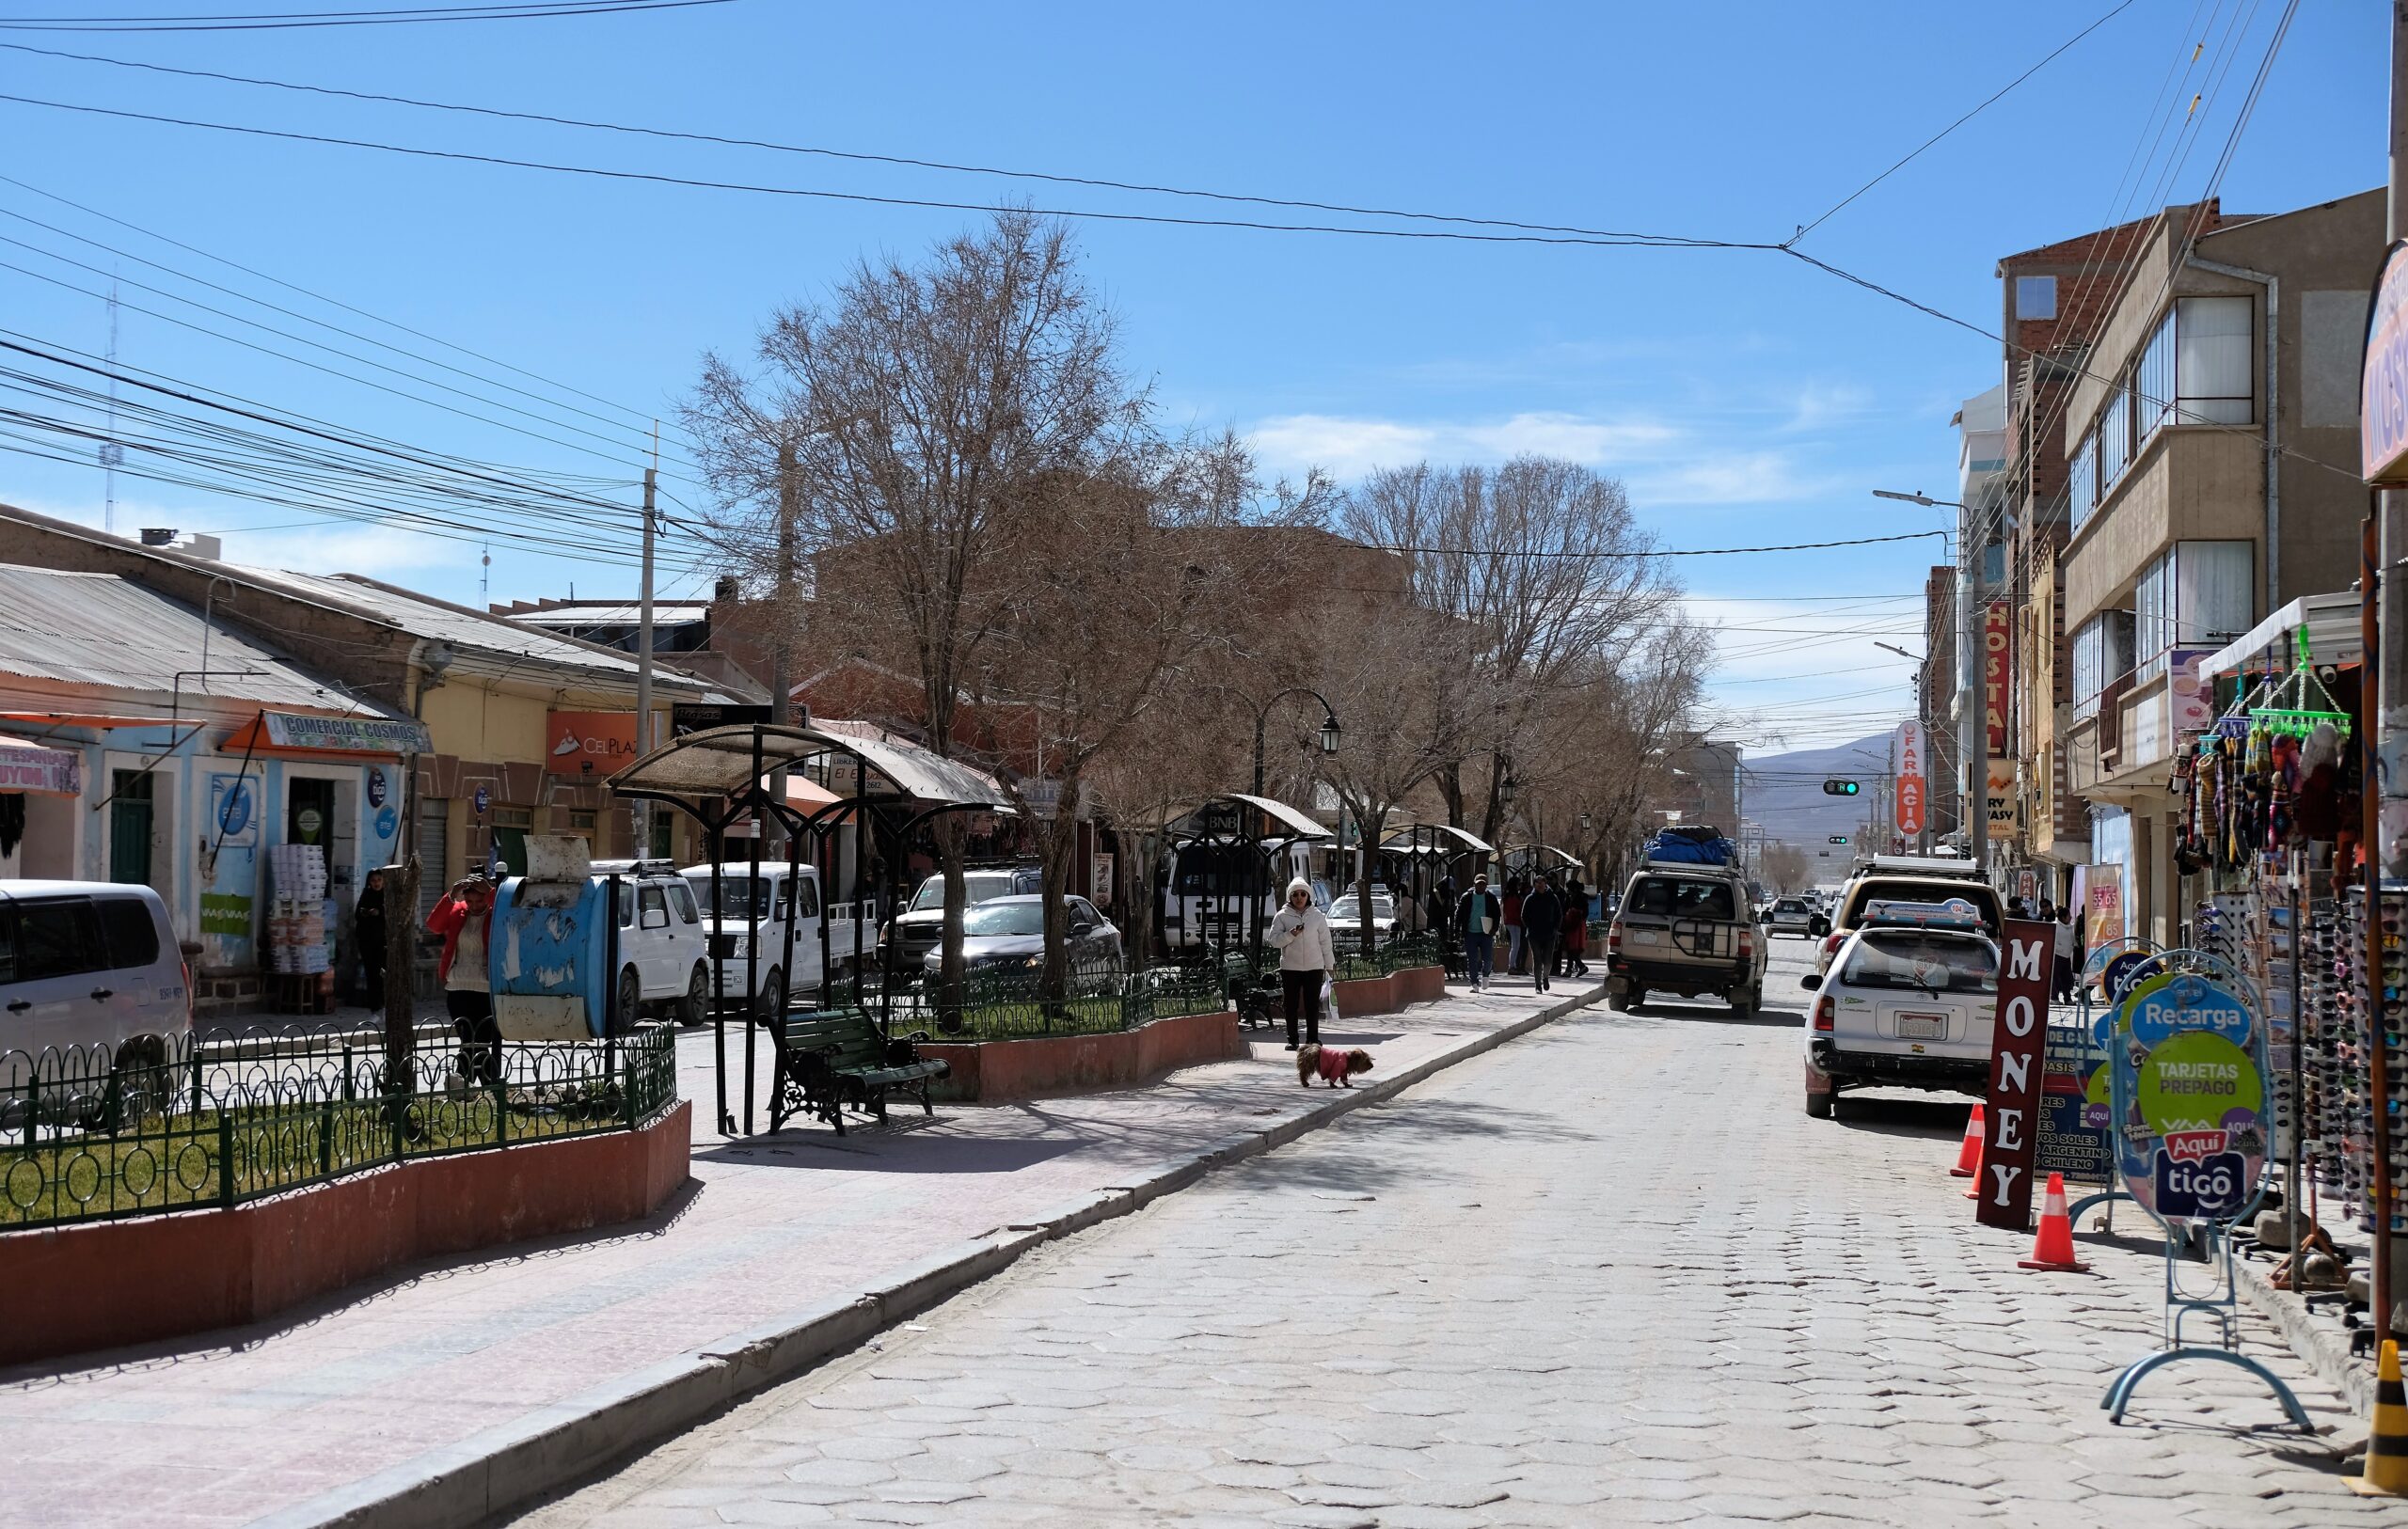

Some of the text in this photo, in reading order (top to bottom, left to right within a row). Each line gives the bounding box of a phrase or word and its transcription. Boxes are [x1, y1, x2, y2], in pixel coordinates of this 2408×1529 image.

[1986, 607, 2007, 753] HOSTAL
[286, 717, 415, 740] COMERCIAL COSMOS
[866, 780, 881, 789] 2612
[1902, 736, 1918, 829] FARMACIA
[1210, 816, 1237, 828] BNB
[2105, 892, 2116, 905] 65
[1952, 904, 1962, 913] 104
[2106, 923, 2118, 936] 85
[2146, 1003, 2241, 1031] Recarga
[2049, 1031, 2065, 1043] DE
[1990, 938, 2044, 1207] MONEY
[2158, 1062, 2239, 1079] TARJETAS
[2161, 1080, 2236, 1096] PREPAGO
[2090, 1111, 2109, 1121] AQUÍ
[2059, 1134, 2099, 1145] SOLES
[2174, 1134, 2220, 1157] Aquí
[2042, 1146, 2111, 1159] ARGENTINO
[2042, 1158, 2094, 1170] CHILENO
